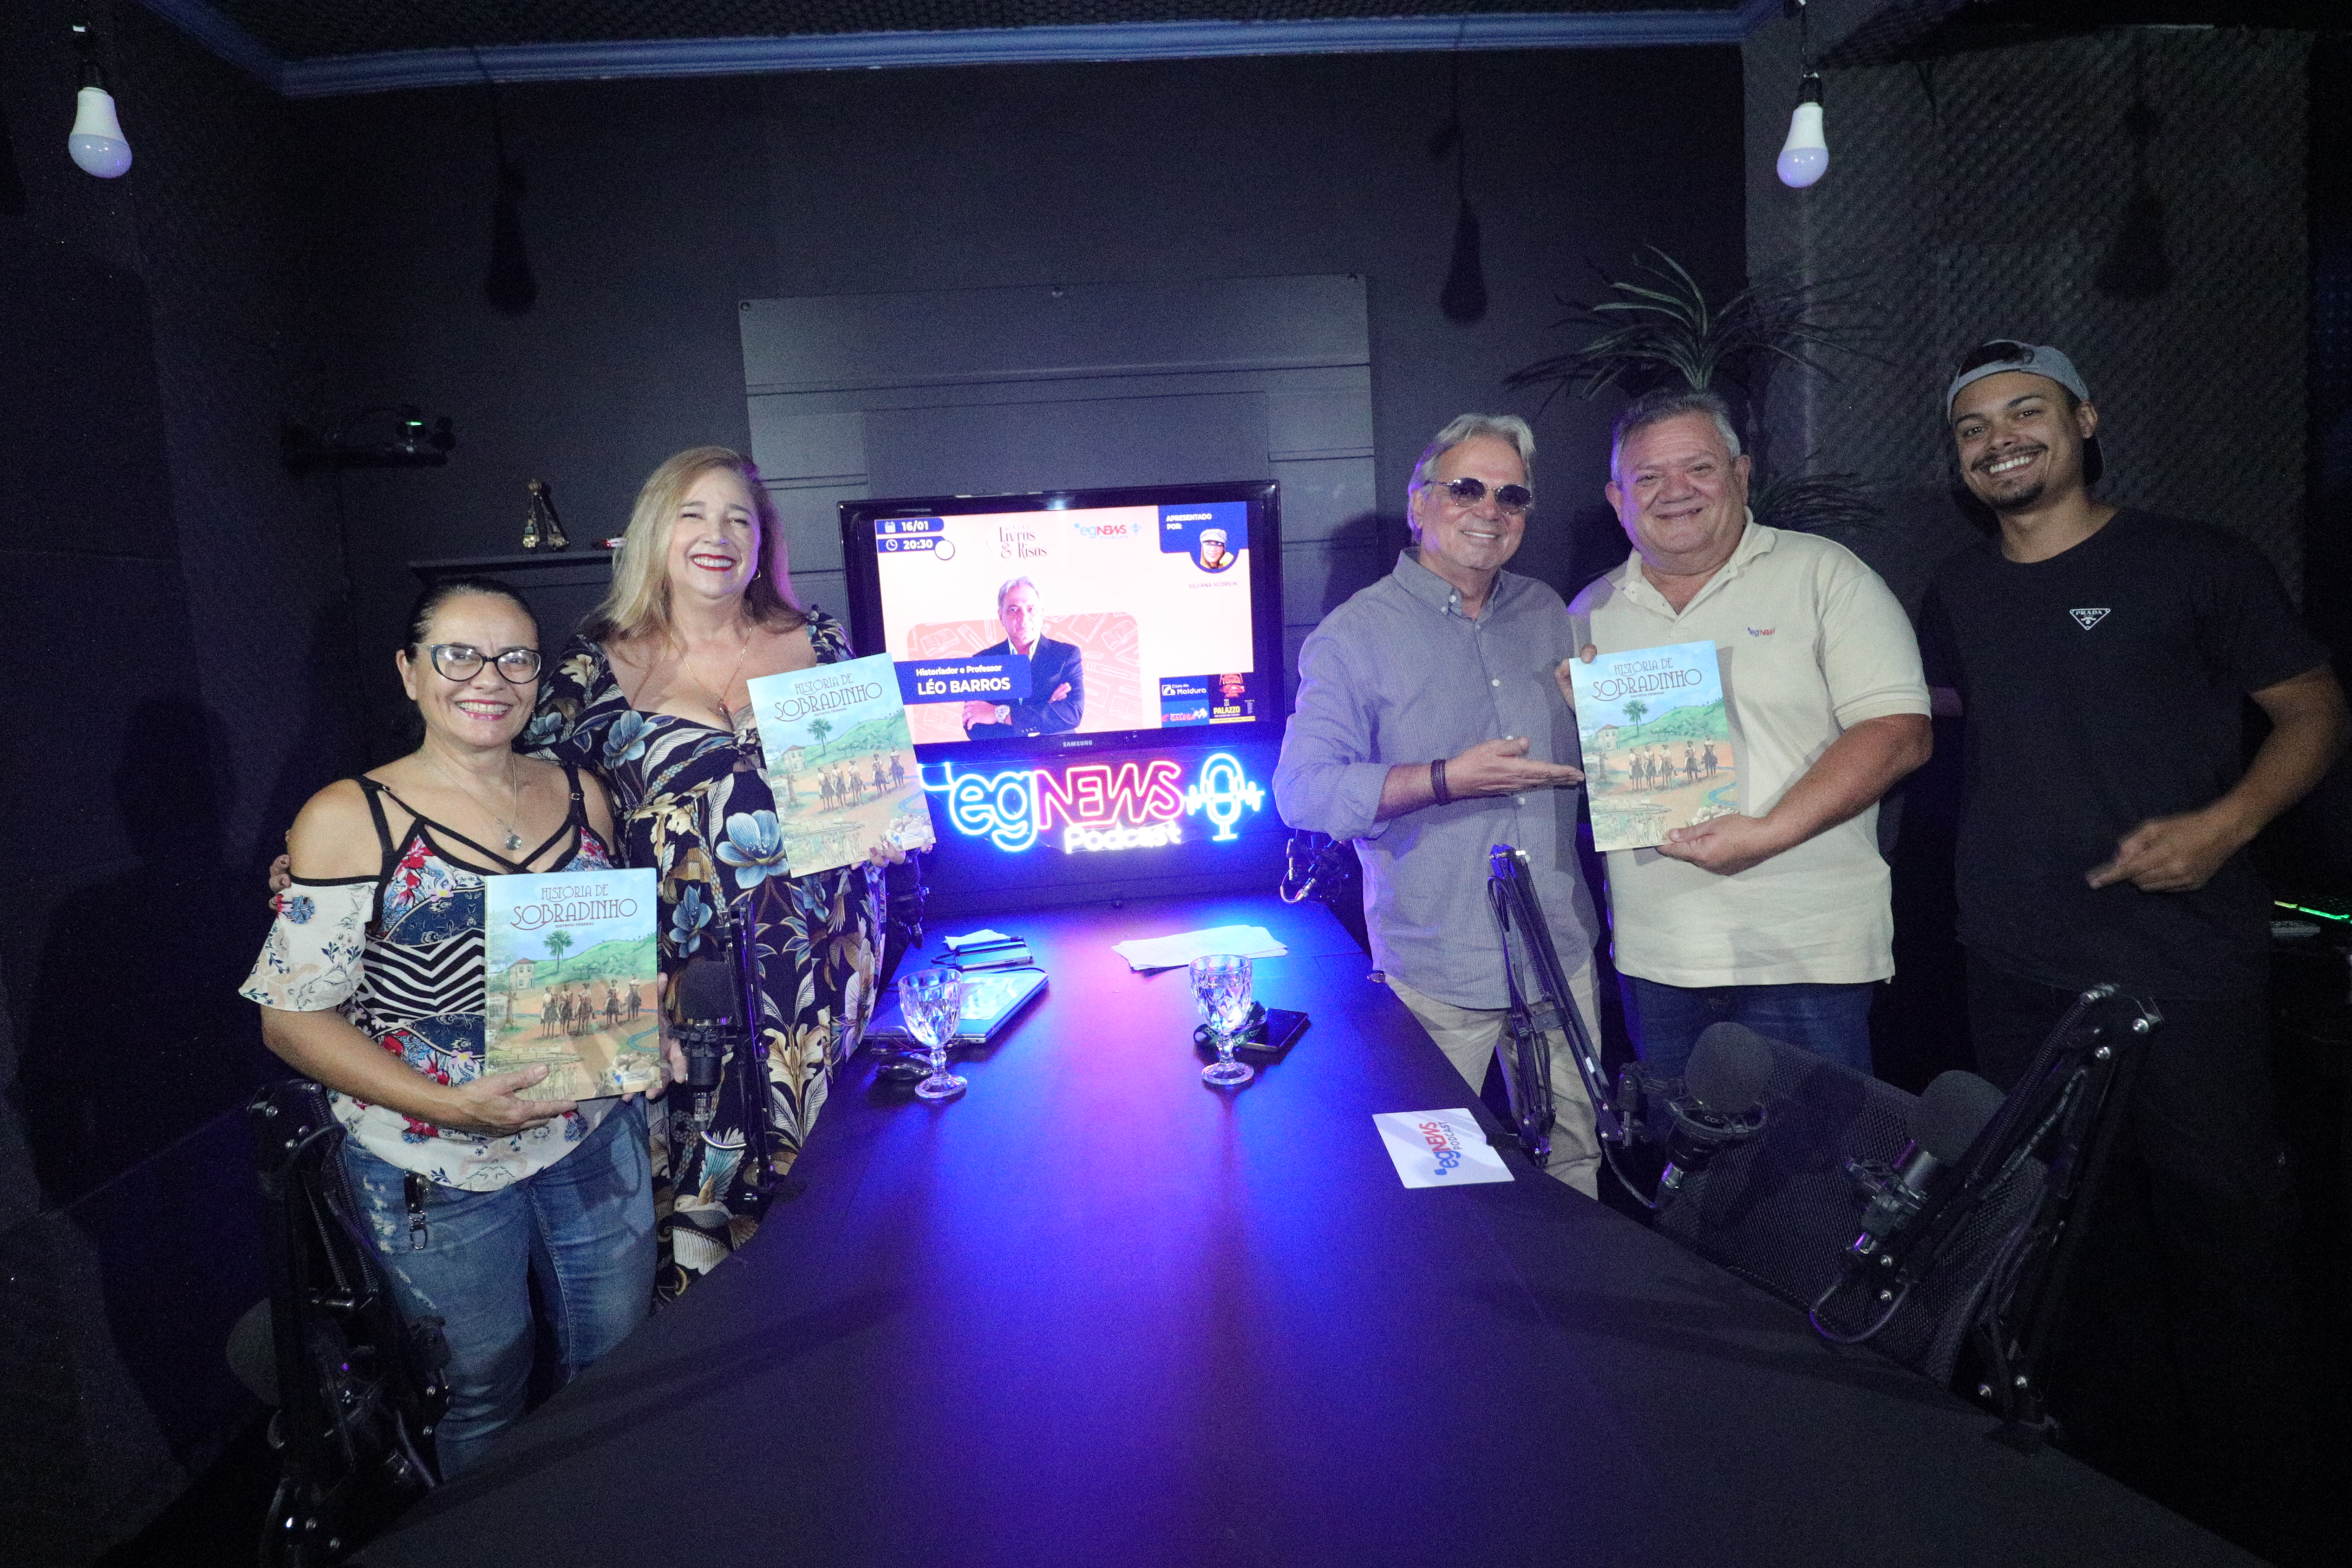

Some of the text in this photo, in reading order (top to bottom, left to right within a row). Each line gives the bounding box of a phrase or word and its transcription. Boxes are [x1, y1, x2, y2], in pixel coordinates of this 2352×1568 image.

[1166, 514, 1212, 522] APRESENTADO
[901, 521, 929, 531] 16/01
[999, 527, 1035, 542] Livros
[903, 539, 933, 550] 20:30
[1018, 543, 1047, 560] Risos
[916, 666, 958, 677] Historiador
[966, 664, 1002, 674] Professor
[1661, 658, 1673, 669] DE
[841, 673, 854, 685] DE
[917, 677, 1011, 695] LÉO BARROS
[1592, 669, 1702, 701] SOBRADINHO
[775, 682, 883, 721] SOBRADINHO
[1213, 706, 1241, 714] PALAZZO
[1064, 821, 1181, 854] Podcast
[595, 884, 609, 896] DE
[510, 898, 638, 930] SOBRADINHO
[1439, 1122, 1463, 1150] PODCAST
